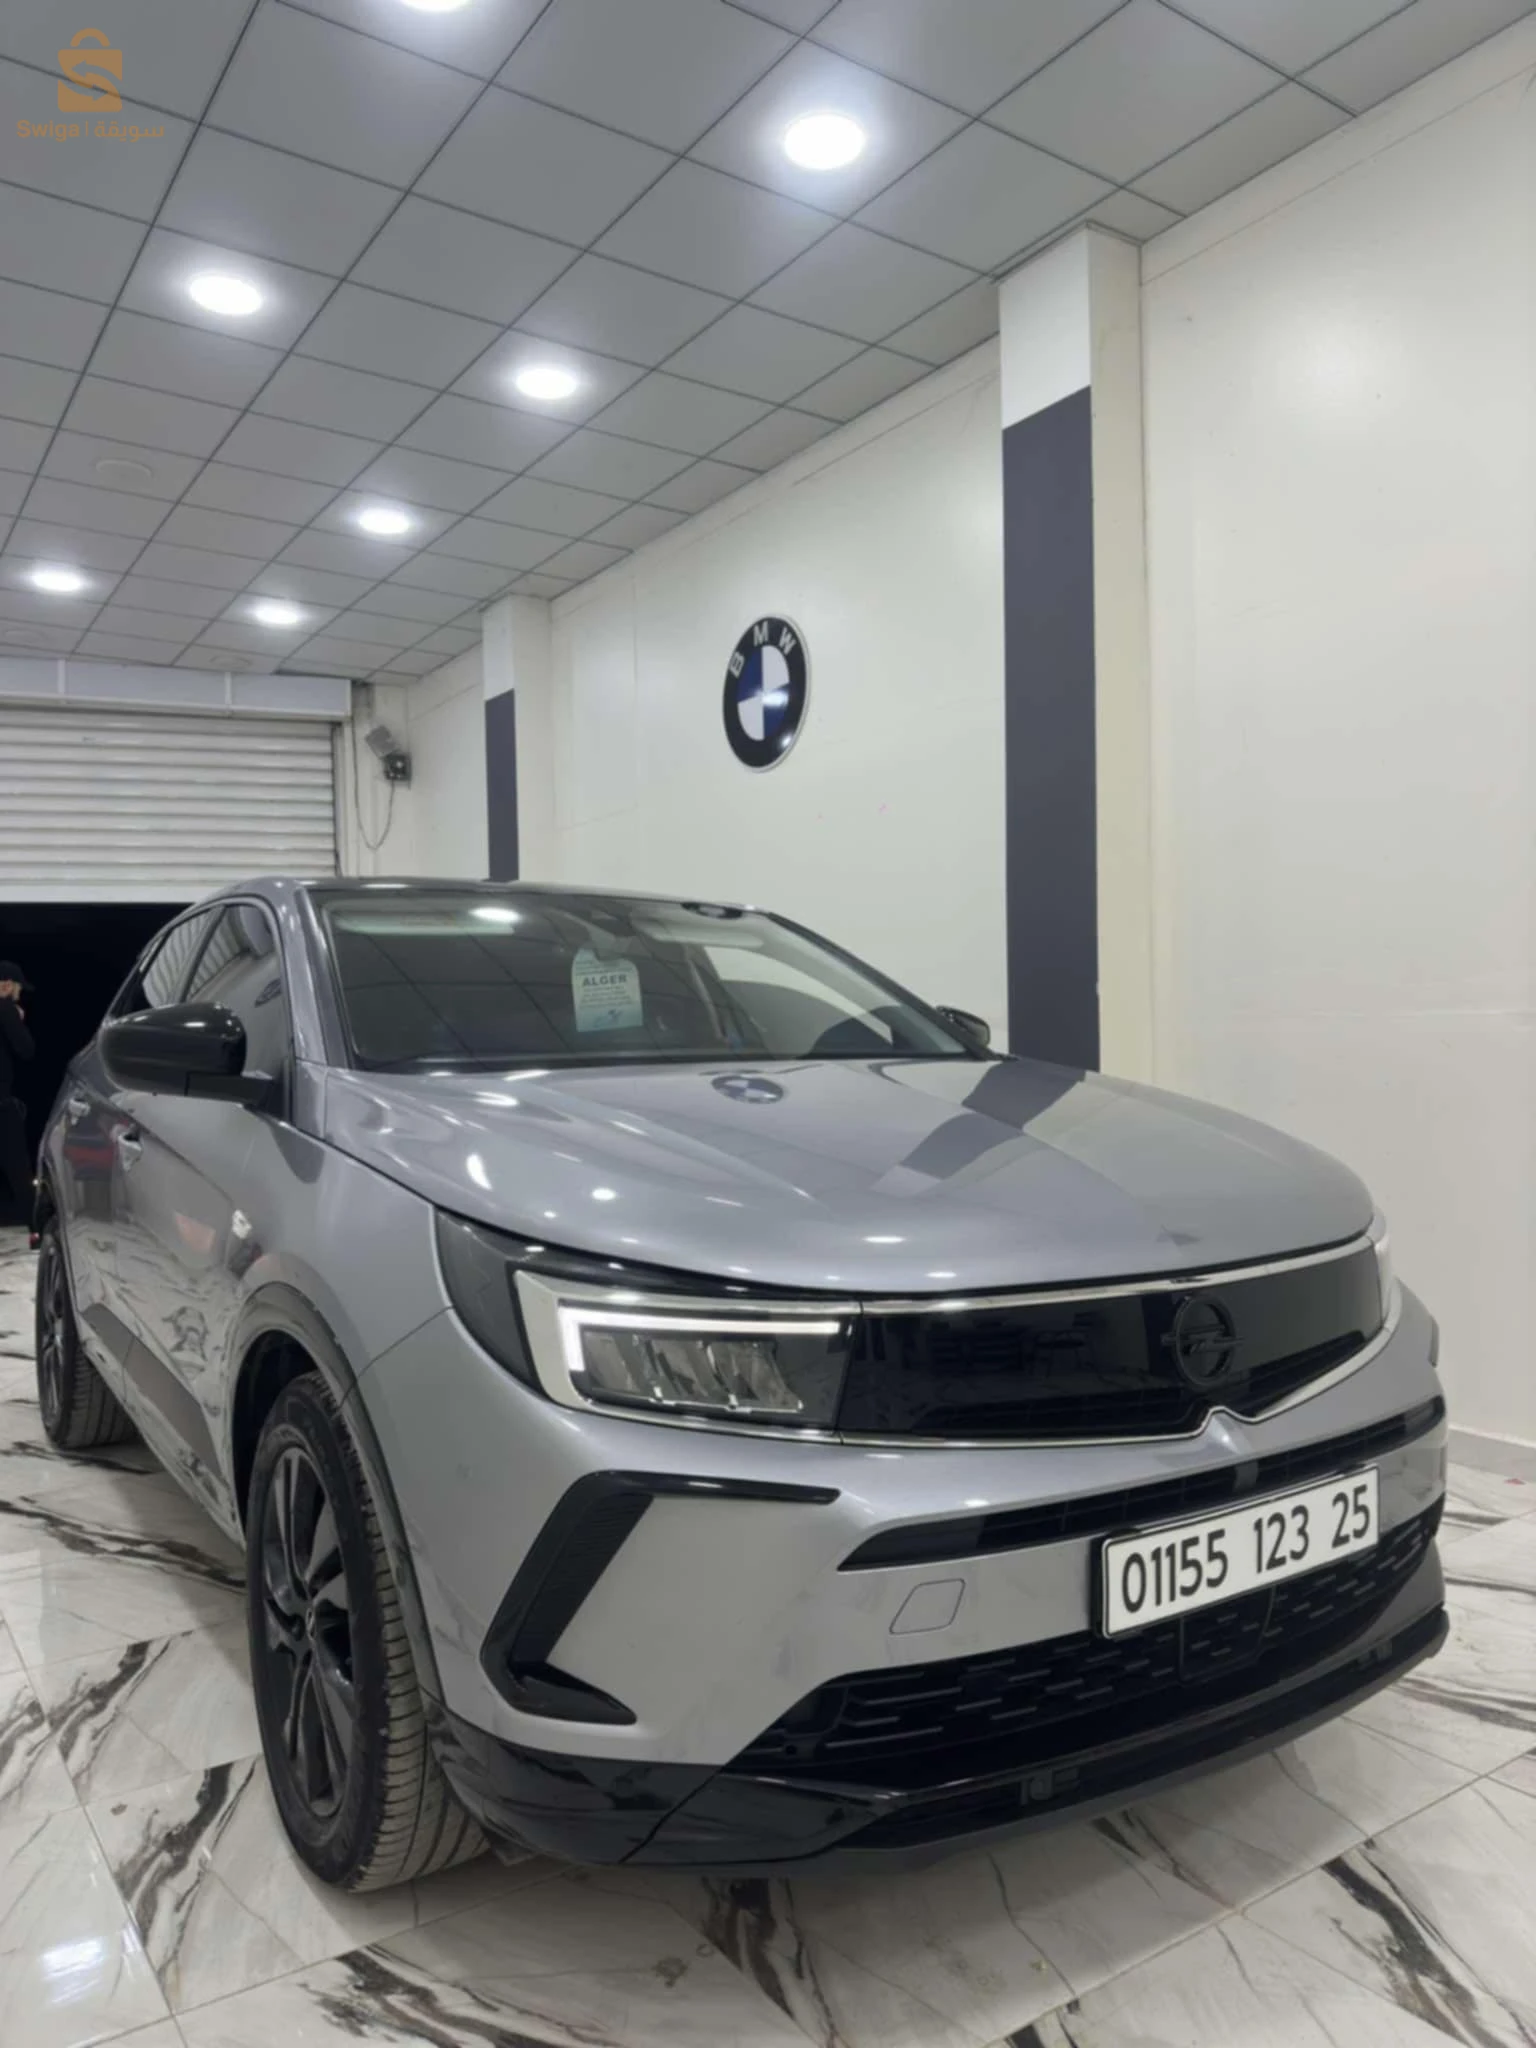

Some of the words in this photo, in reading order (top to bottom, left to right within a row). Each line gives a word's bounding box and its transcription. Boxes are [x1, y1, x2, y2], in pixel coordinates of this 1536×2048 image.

[729, 620, 797, 679] BMW
[1121, 1528, 1229, 1614] 01155
[1253, 1504, 1310, 1574] 123
[1331, 1483, 1371, 1549] 25
